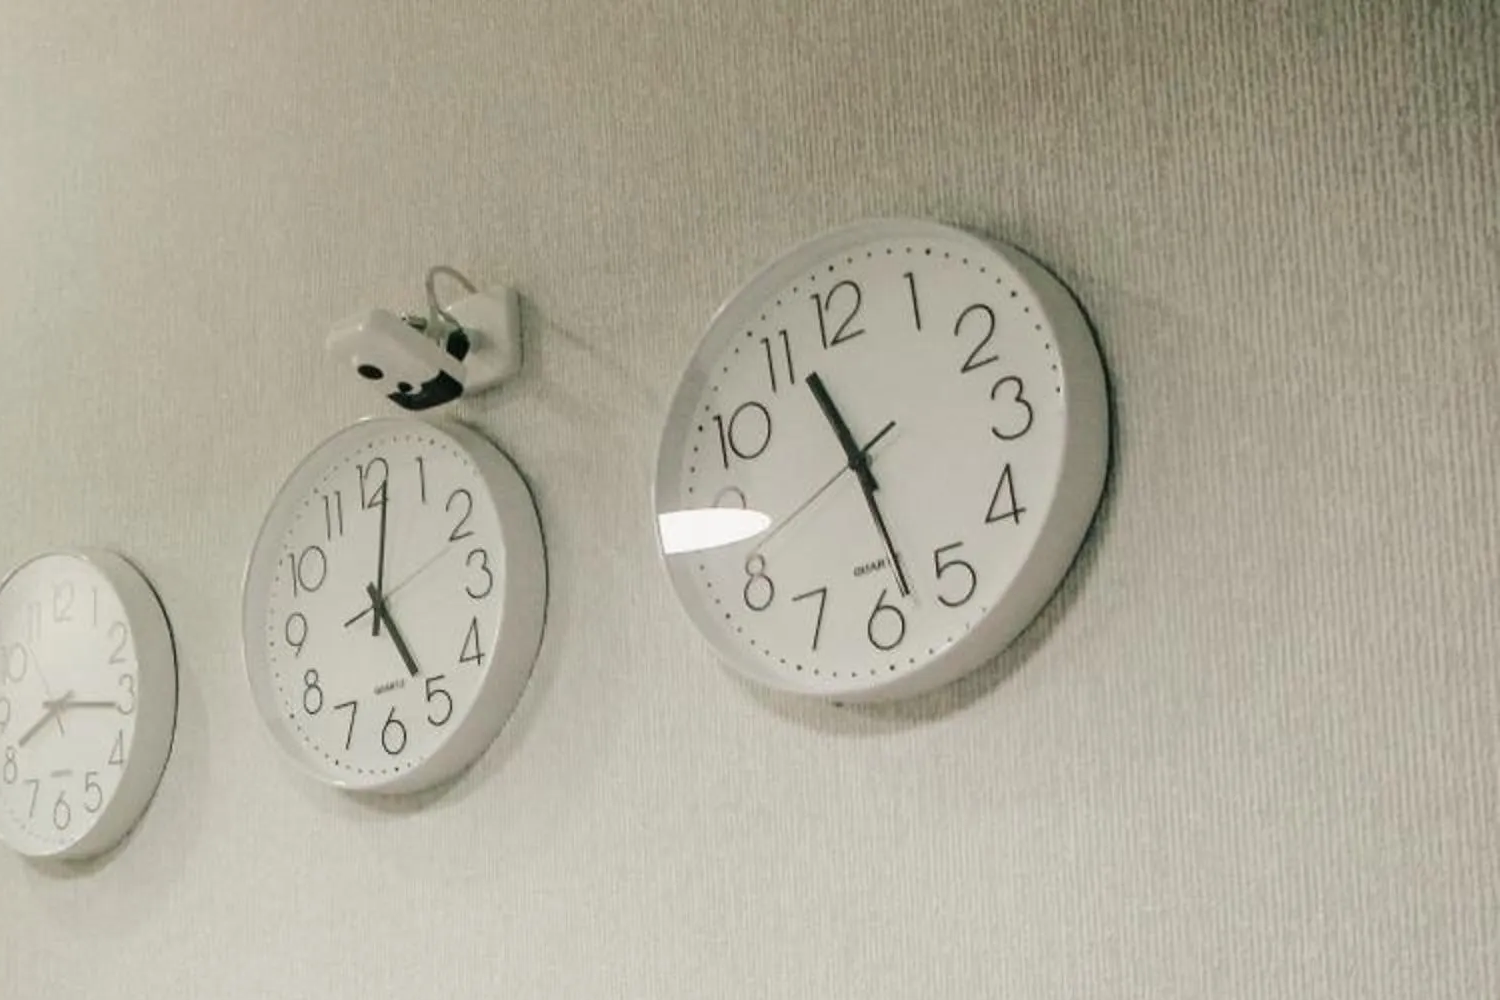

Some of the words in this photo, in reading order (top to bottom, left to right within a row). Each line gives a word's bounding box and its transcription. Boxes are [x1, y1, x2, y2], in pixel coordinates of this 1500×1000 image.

[810, 279, 866, 350] 12
[903, 272, 922, 332] 1
[760, 328, 795, 393] 11
[954, 303, 1000, 374] 2
[990, 375, 1034, 440] 3
[711, 400, 773, 470] 10
[355, 456, 390, 511] 12
[415, 455, 427, 505] 1
[984, 462, 1027, 525] 4
[321, 489, 344, 541] 11
[445, 488, 475, 543] 2
[287, 544, 328, 599] 10
[465, 547, 494, 600] 3
[743, 552, 775, 612] 8
[933, 541, 978, 607] 5
[52, 579, 76, 623] 12
[91, 585, 99, 627] 1
[791, 586, 828, 652] 7
[867, 588, 906, 651] 6
[108, 620, 129, 666] 2
[284, 611, 309, 659] 9
[458, 616, 486, 666] 4
[116, 672, 135, 716] 3
[302, 668, 324, 715] 8
[425, 674, 454, 727] 5
[107, 728, 125, 767] 4
[333, 700, 358, 751] 7
[381, 706, 407, 755] 6
[2, 745, 19, 785] 8
[24, 778, 41, 820] 7
[52, 789, 72, 832] 6
[84, 770, 104, 814] 5
